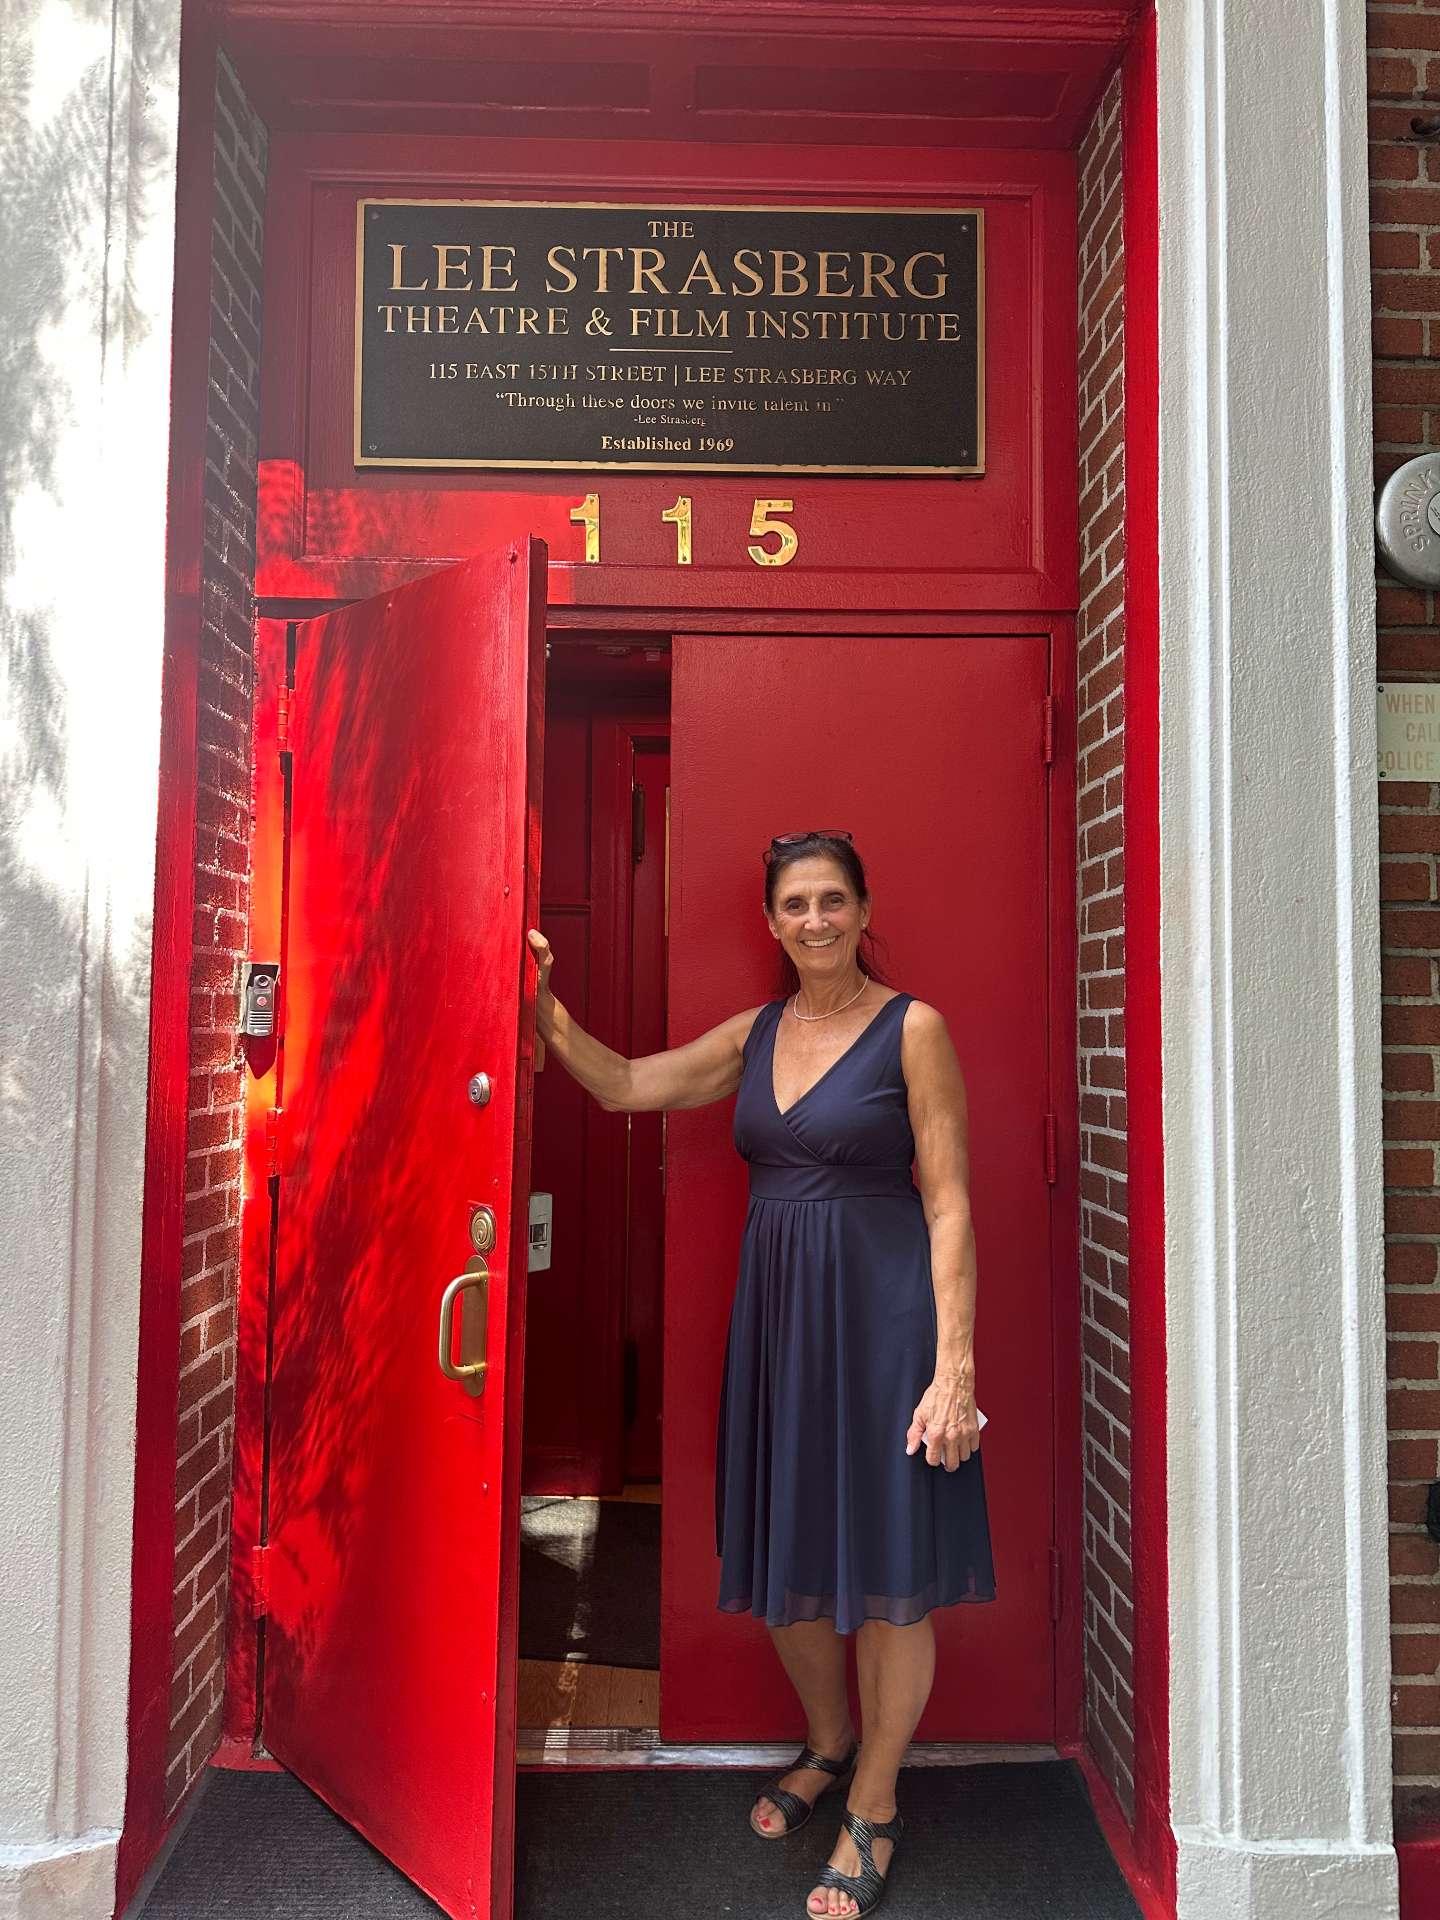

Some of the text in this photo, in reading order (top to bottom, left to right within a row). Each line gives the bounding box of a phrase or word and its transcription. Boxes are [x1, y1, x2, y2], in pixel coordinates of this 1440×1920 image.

[647, 220, 695, 238] THE
[387, 243, 949, 299] LEE STRASBERG
[377, 305, 961, 342] THEATRE & FILM INSTITUTE
[429, 363, 458, 379] 115
[465, 363, 520, 380] EAST
[528, 364, 578, 381] 15TH
[585, 365, 667, 382] STREET
[685, 366, 726, 383] LEE
[733, 368, 858, 386] STRASBERG
[865, 369, 912, 386] WAY
[582, 394, 624, 409] these
[630, 395, 675, 409] doors
[683, 398, 704, 410] we
[711, 395, 758, 411] invite
[763, 397, 810, 412] talent
[601, 435, 734, 452] Established 1969
[1385, 693, 1435, 714] WHEN
[1406, 722, 1440, 743] CAL
